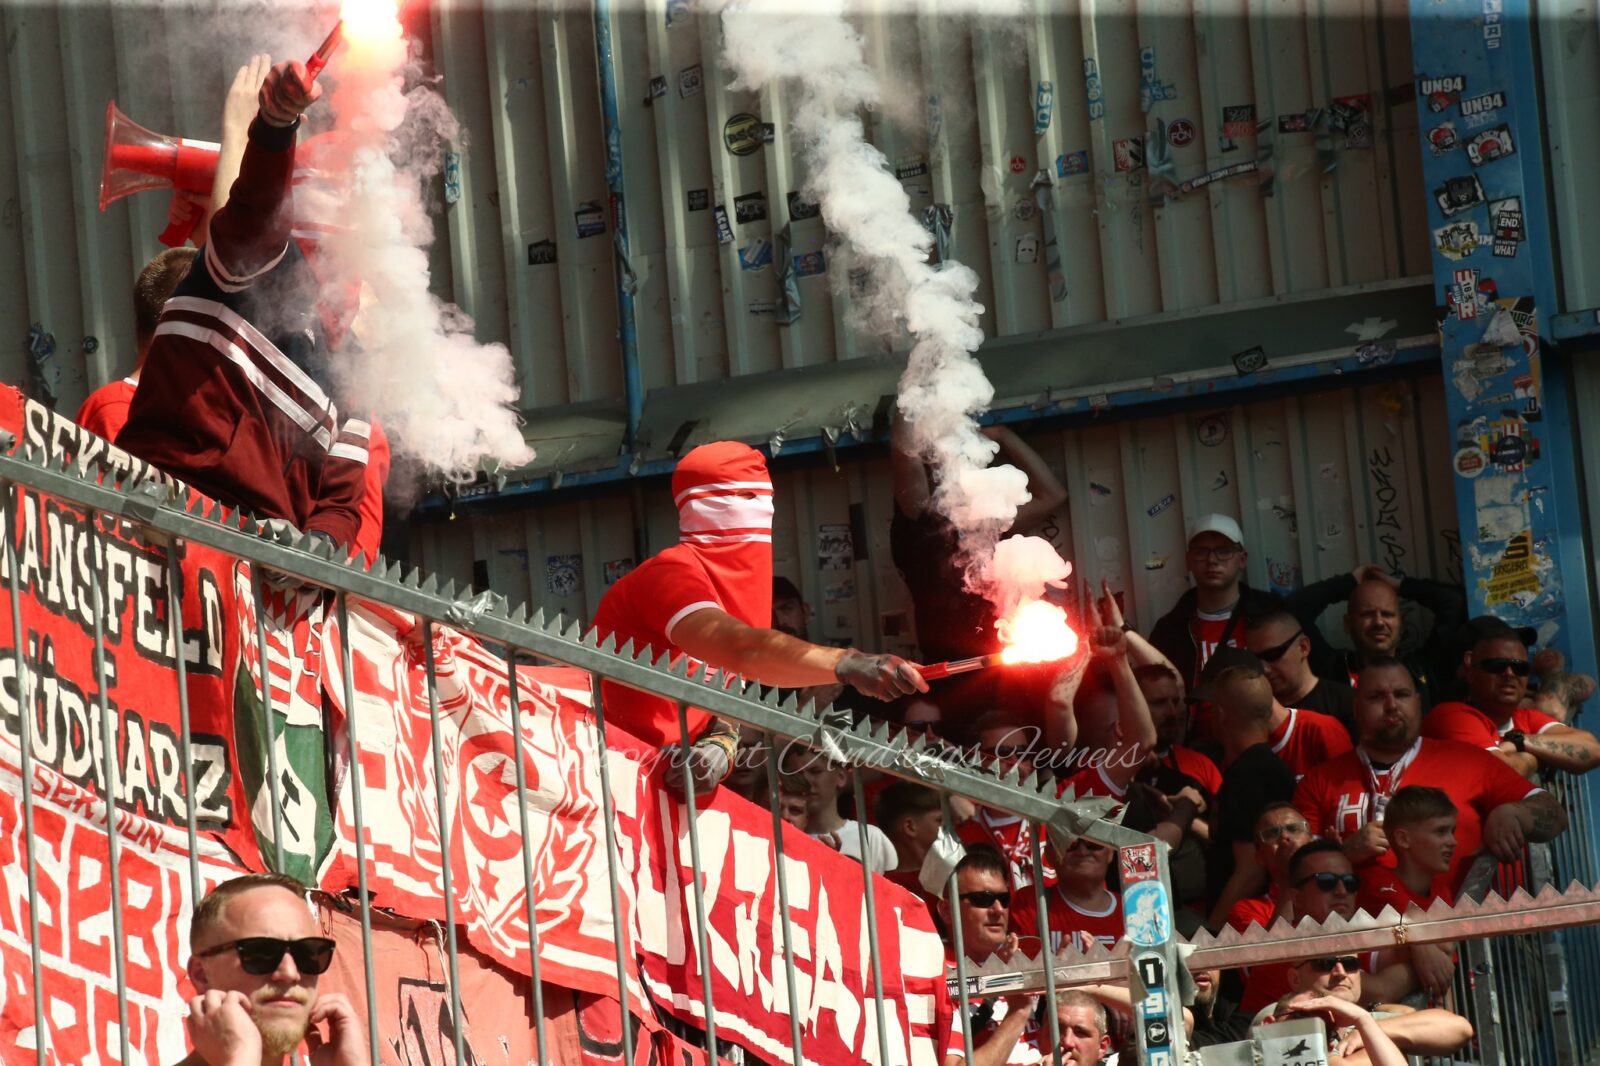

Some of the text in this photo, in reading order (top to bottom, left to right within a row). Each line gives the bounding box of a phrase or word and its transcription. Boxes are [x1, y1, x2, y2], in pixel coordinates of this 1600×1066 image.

[1421, 77, 1463, 95] UN94
[1461, 94, 1503, 116] UN94
[1494, 245, 1516, 256] WHAT
[468, 667, 536, 739] HFC
[0, 640, 230, 821] SÜDHARZ
